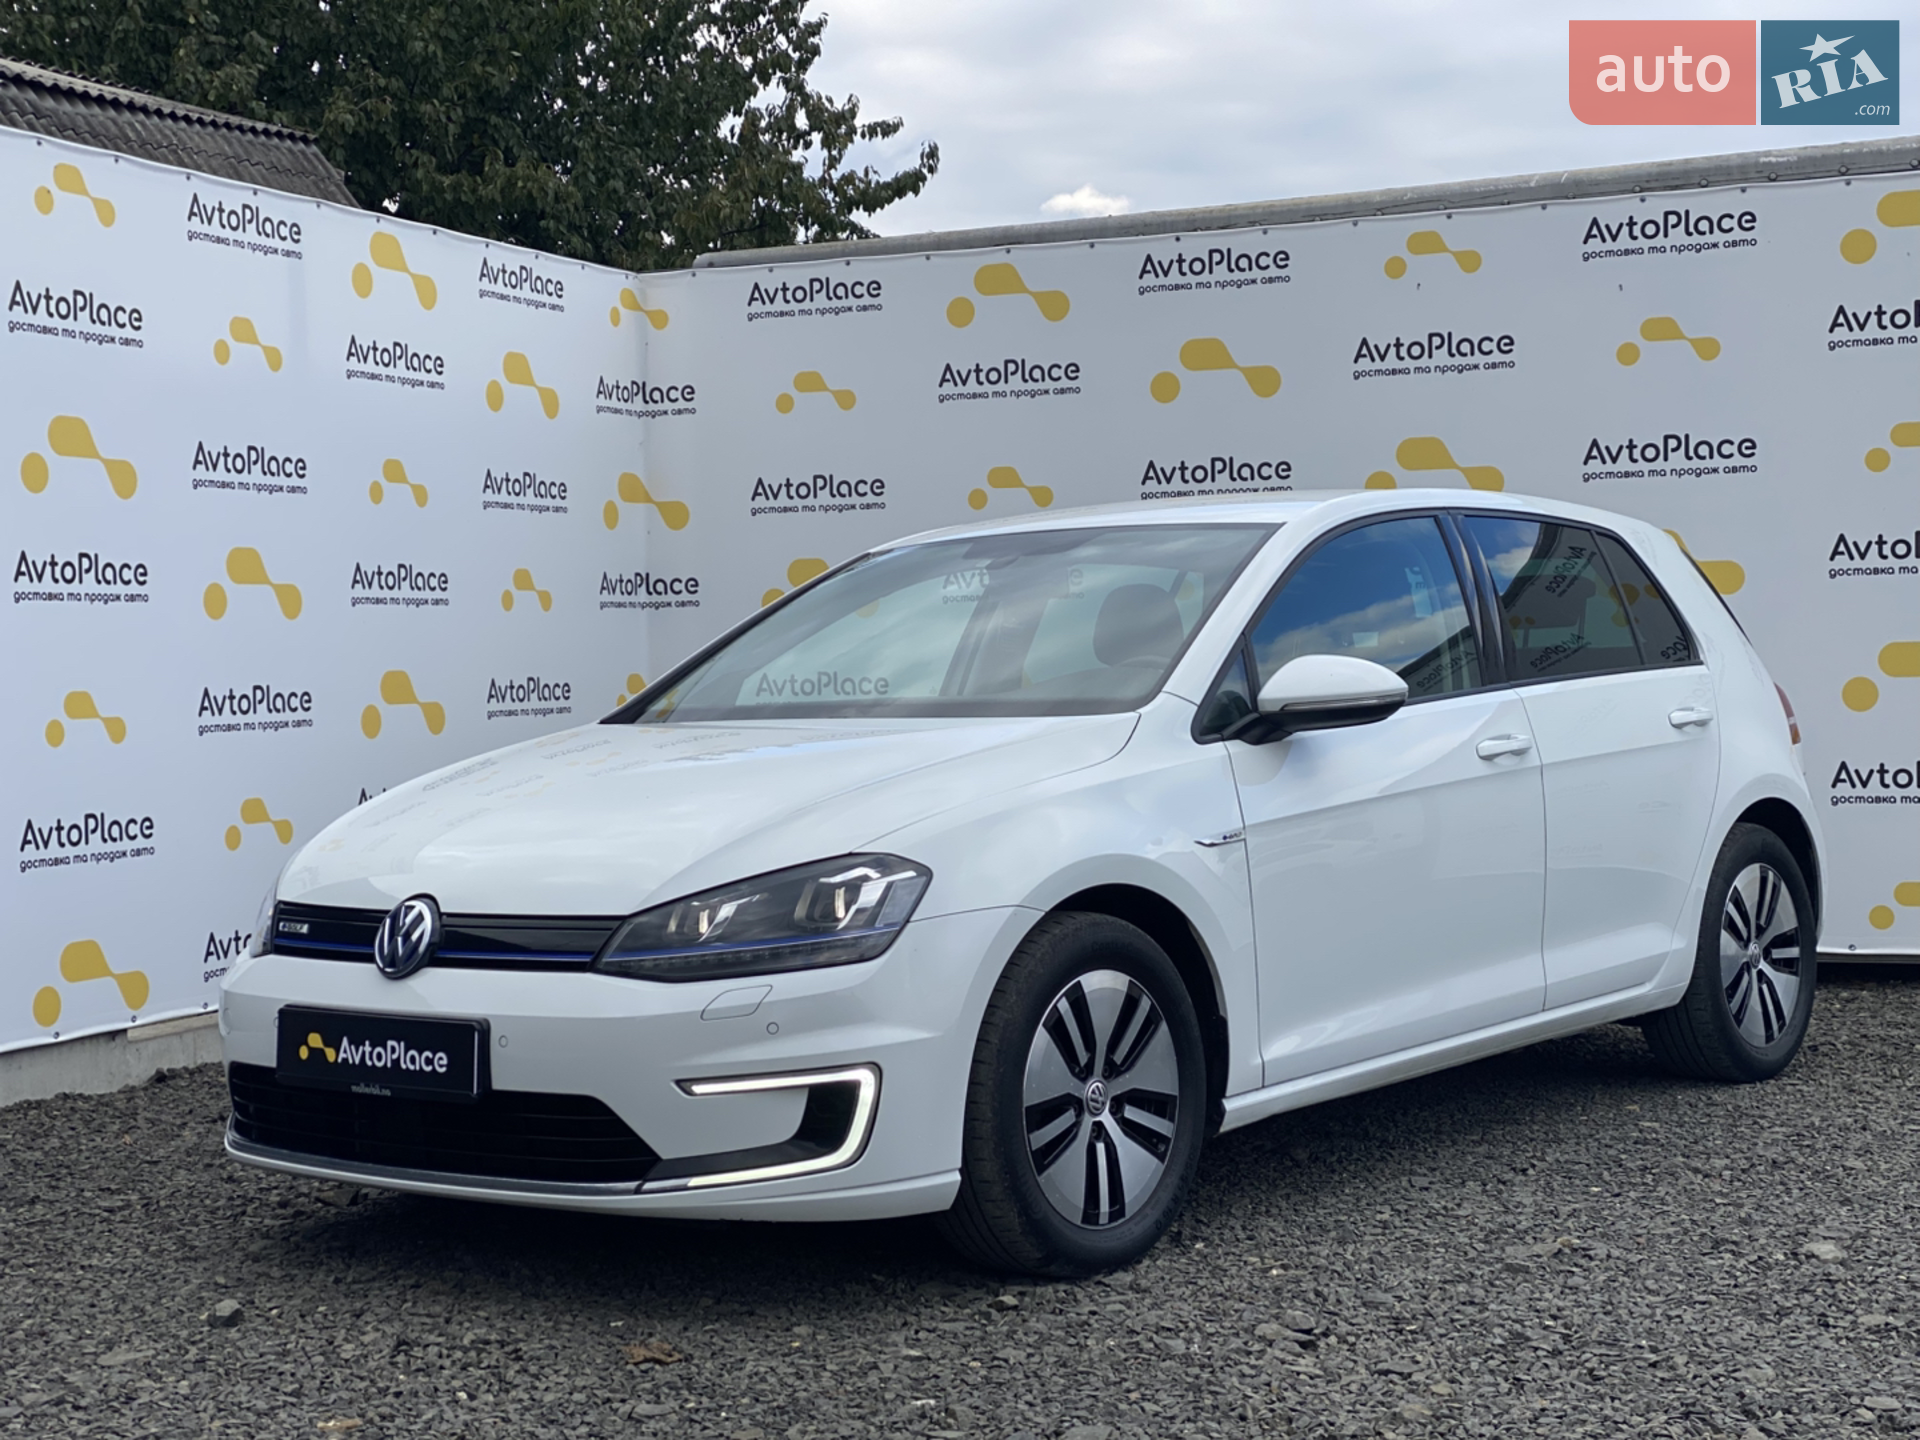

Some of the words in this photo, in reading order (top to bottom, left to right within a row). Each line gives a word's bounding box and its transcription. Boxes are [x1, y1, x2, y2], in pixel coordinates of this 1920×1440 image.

[188, 192, 301, 244] AvtoPlace
[1583, 209, 1756, 244] AvtoPlace
[1139, 248, 1290, 280] AvtoPlace
[1582, 247, 1645, 262] доставка
[1648, 245, 1667, 254] та
[1670, 241, 1720, 255] продаж
[1722, 238, 1758, 249] авто
[479, 257, 564, 299] AvtoPlace
[748, 277, 882, 306] AvtoPlace
[1138, 282, 1193, 296] доставка
[1195, 281, 1212, 289] та
[1214, 278, 1258, 290] продаж
[1260, 275, 1291, 285] авто
[8, 280, 142, 331] AvtoPlace
[747, 310, 796, 322] доставка
[798, 308, 813, 316] та
[815, 306, 854, 316] продаж
[855, 303, 883, 312] авто
[346, 335, 444, 376] AvtoPlace
[1354, 332, 1514, 364] AvtoPlace
[1828, 336, 1894, 352] доставка
[1898, 335, 1918, 344] та
[938, 358, 1080, 388] AvtoPlace
[1352, 367, 1411, 380] доставка
[1413, 366, 1432, 374] та
[1434, 363, 1480, 375] продаж
[1483, 360, 1516, 370] авто
[596, 376, 695, 404] AvtoPlace
[938, 391, 989, 404] доставка
[992, 390, 1008, 398] та
[1010, 388, 1050, 399] продаж
[1052, 386, 1081, 395] авто
[192, 441, 306, 479] AvtoPlace
[1583, 433, 1757, 466] AvtoPlace
[483, 468, 567, 500] AvtoPlace
[1141, 456, 1292, 486] AvtoPlace
[1582, 470, 1645, 483] доставка
[1648, 468, 1667, 477] та
[1670, 466, 1720, 479] продаж
[1722, 464, 1758, 474] авто
[751, 474, 885, 502] AvtoPlace
[750, 505, 799, 517] доставка
[801, 504, 816, 512] та
[818, 503, 857, 514] продаж
[858, 502, 886, 510] авто
[14, 550, 148, 586] AvtoPlace
[351, 562, 448, 592] AvtoPlace
[1828, 566, 1895, 579] доставка
[1898, 566, 1919, 574] та
[600, 572, 699, 596] AvtoPlace
[487, 677, 571, 704] AvtoPlace
[755, 671, 889, 697] AvtoPlace
[198, 685, 312, 717] AvtoPlace
[1830, 795, 1897, 806] доставка
[20, 812, 154, 852] AvtoPlace
[337, 1036, 447, 1073] AvtoPlace
